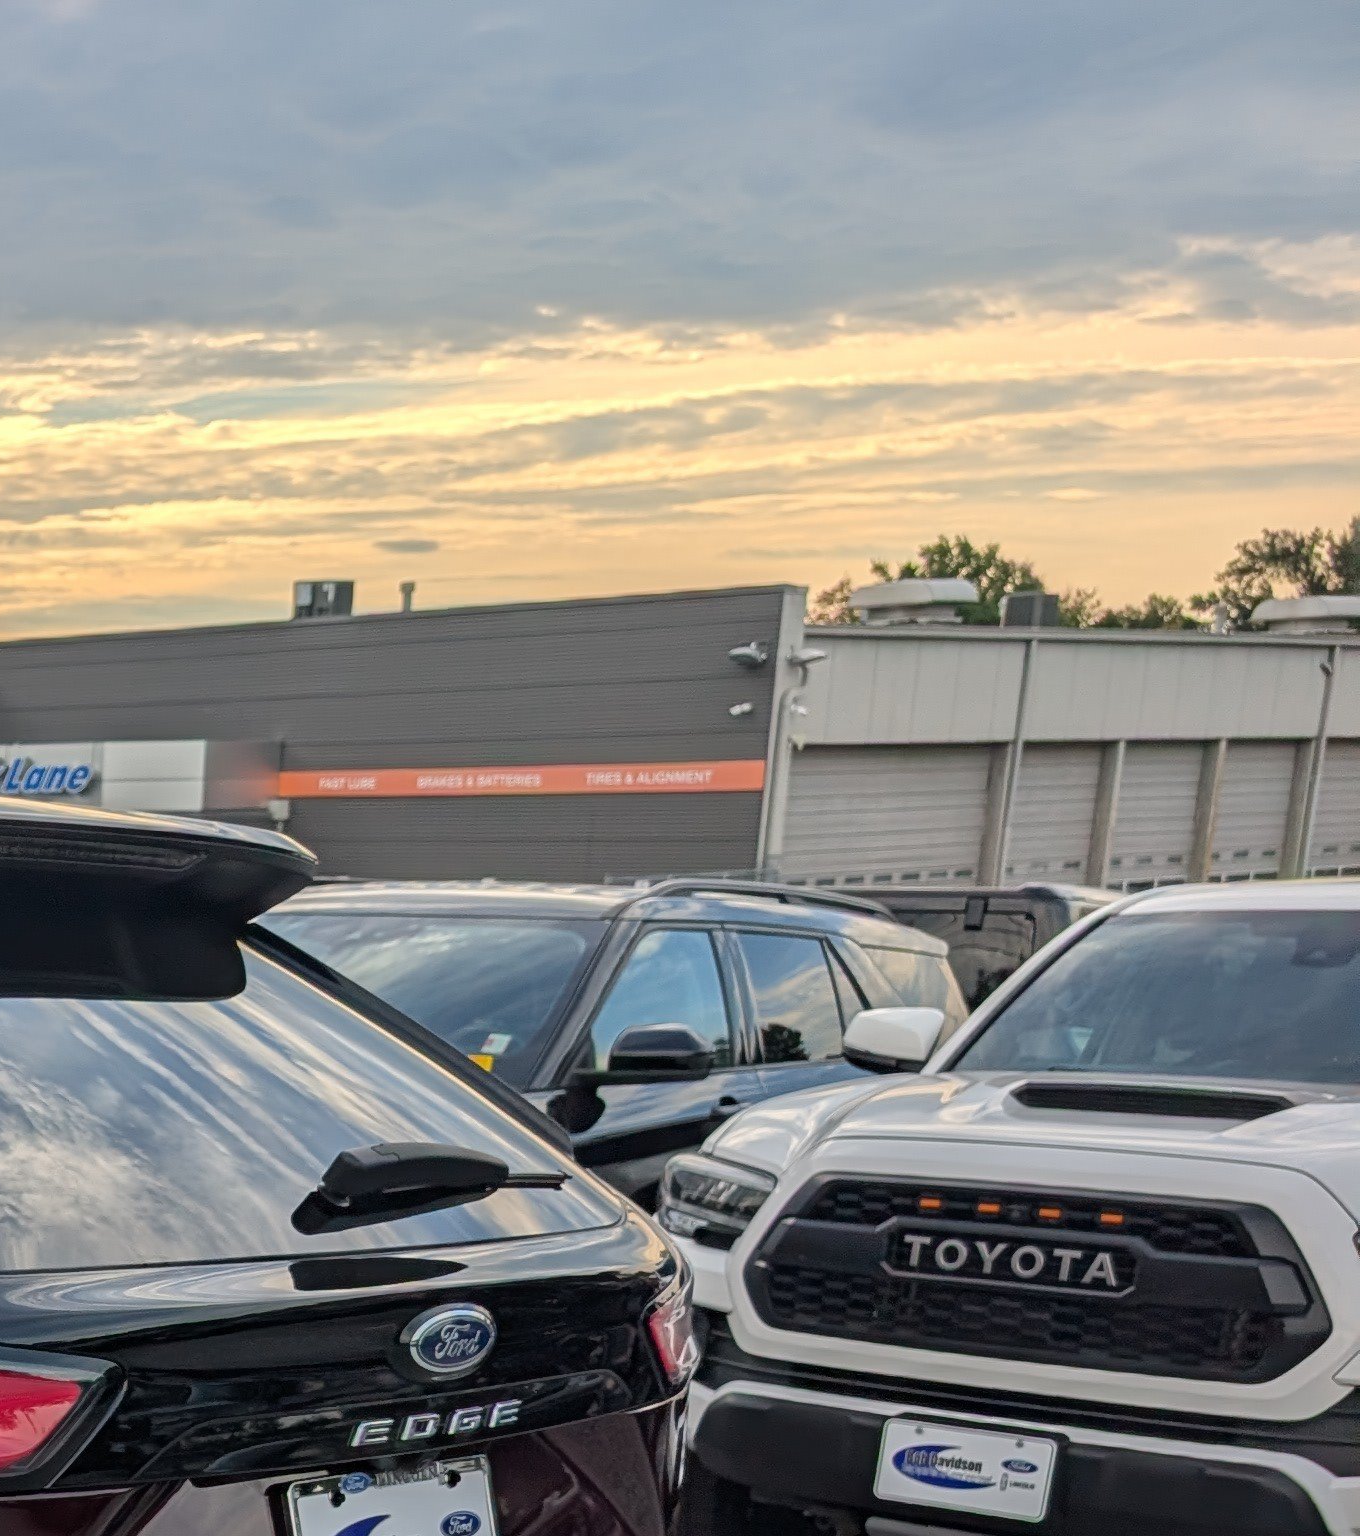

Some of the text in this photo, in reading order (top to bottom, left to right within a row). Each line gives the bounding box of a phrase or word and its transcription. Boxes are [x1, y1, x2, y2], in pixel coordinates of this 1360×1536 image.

[2, 757, 93, 794] Lane
[585, 772, 623, 786] TIRES
[636, 769, 713, 785] ALIGNMENT
[903, 1234, 1117, 1287] TOYOTA
[434, 1323, 482, 1360] Ford
[349, 1399, 523, 1447] EDGE
[930, 1451, 983, 1473] Davidson
